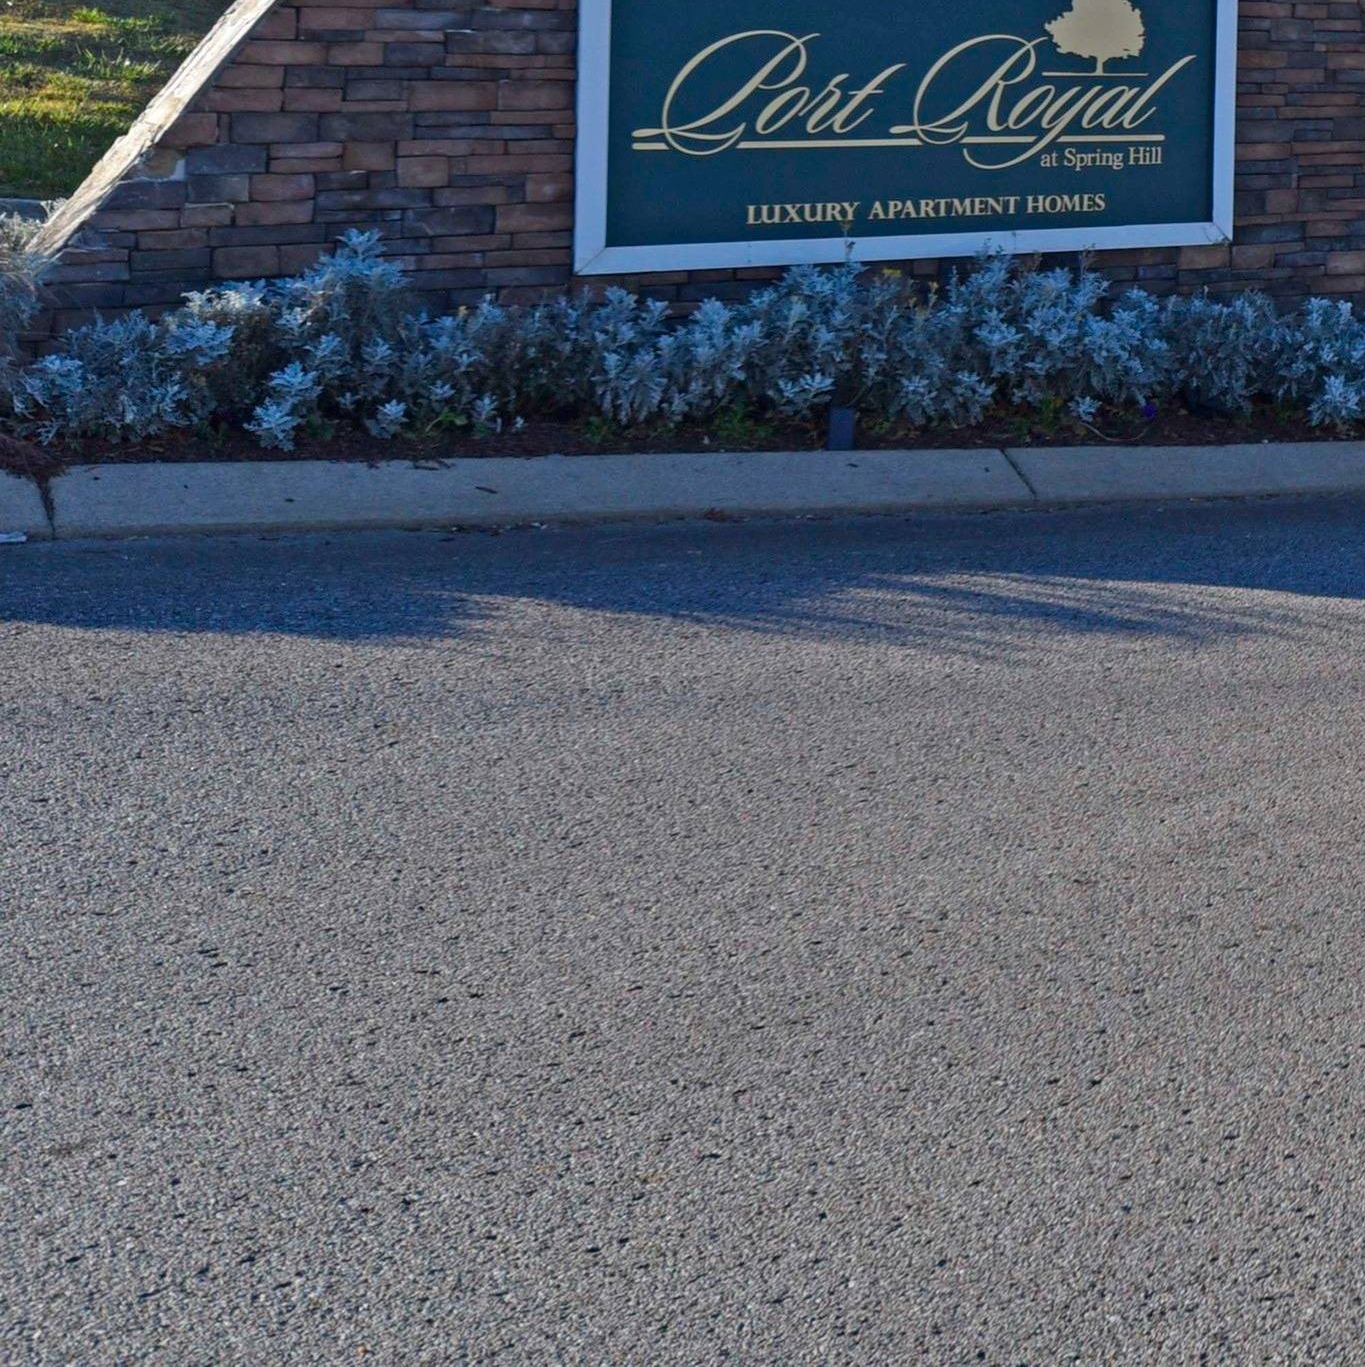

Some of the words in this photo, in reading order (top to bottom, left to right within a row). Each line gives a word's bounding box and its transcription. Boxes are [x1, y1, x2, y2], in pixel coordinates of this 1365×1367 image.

[632, 30, 906, 155] Port
[889, 34, 1197, 169] Royal
[1040, 150, 1059, 167] at
[1063, 147, 1124, 171] Spring
[1128, 146, 1162, 165] Hill
[746, 201, 860, 225] LUXURY
[868, 196, 1020, 220] APARTMENT
[1026, 193, 1106, 214] HOMES
